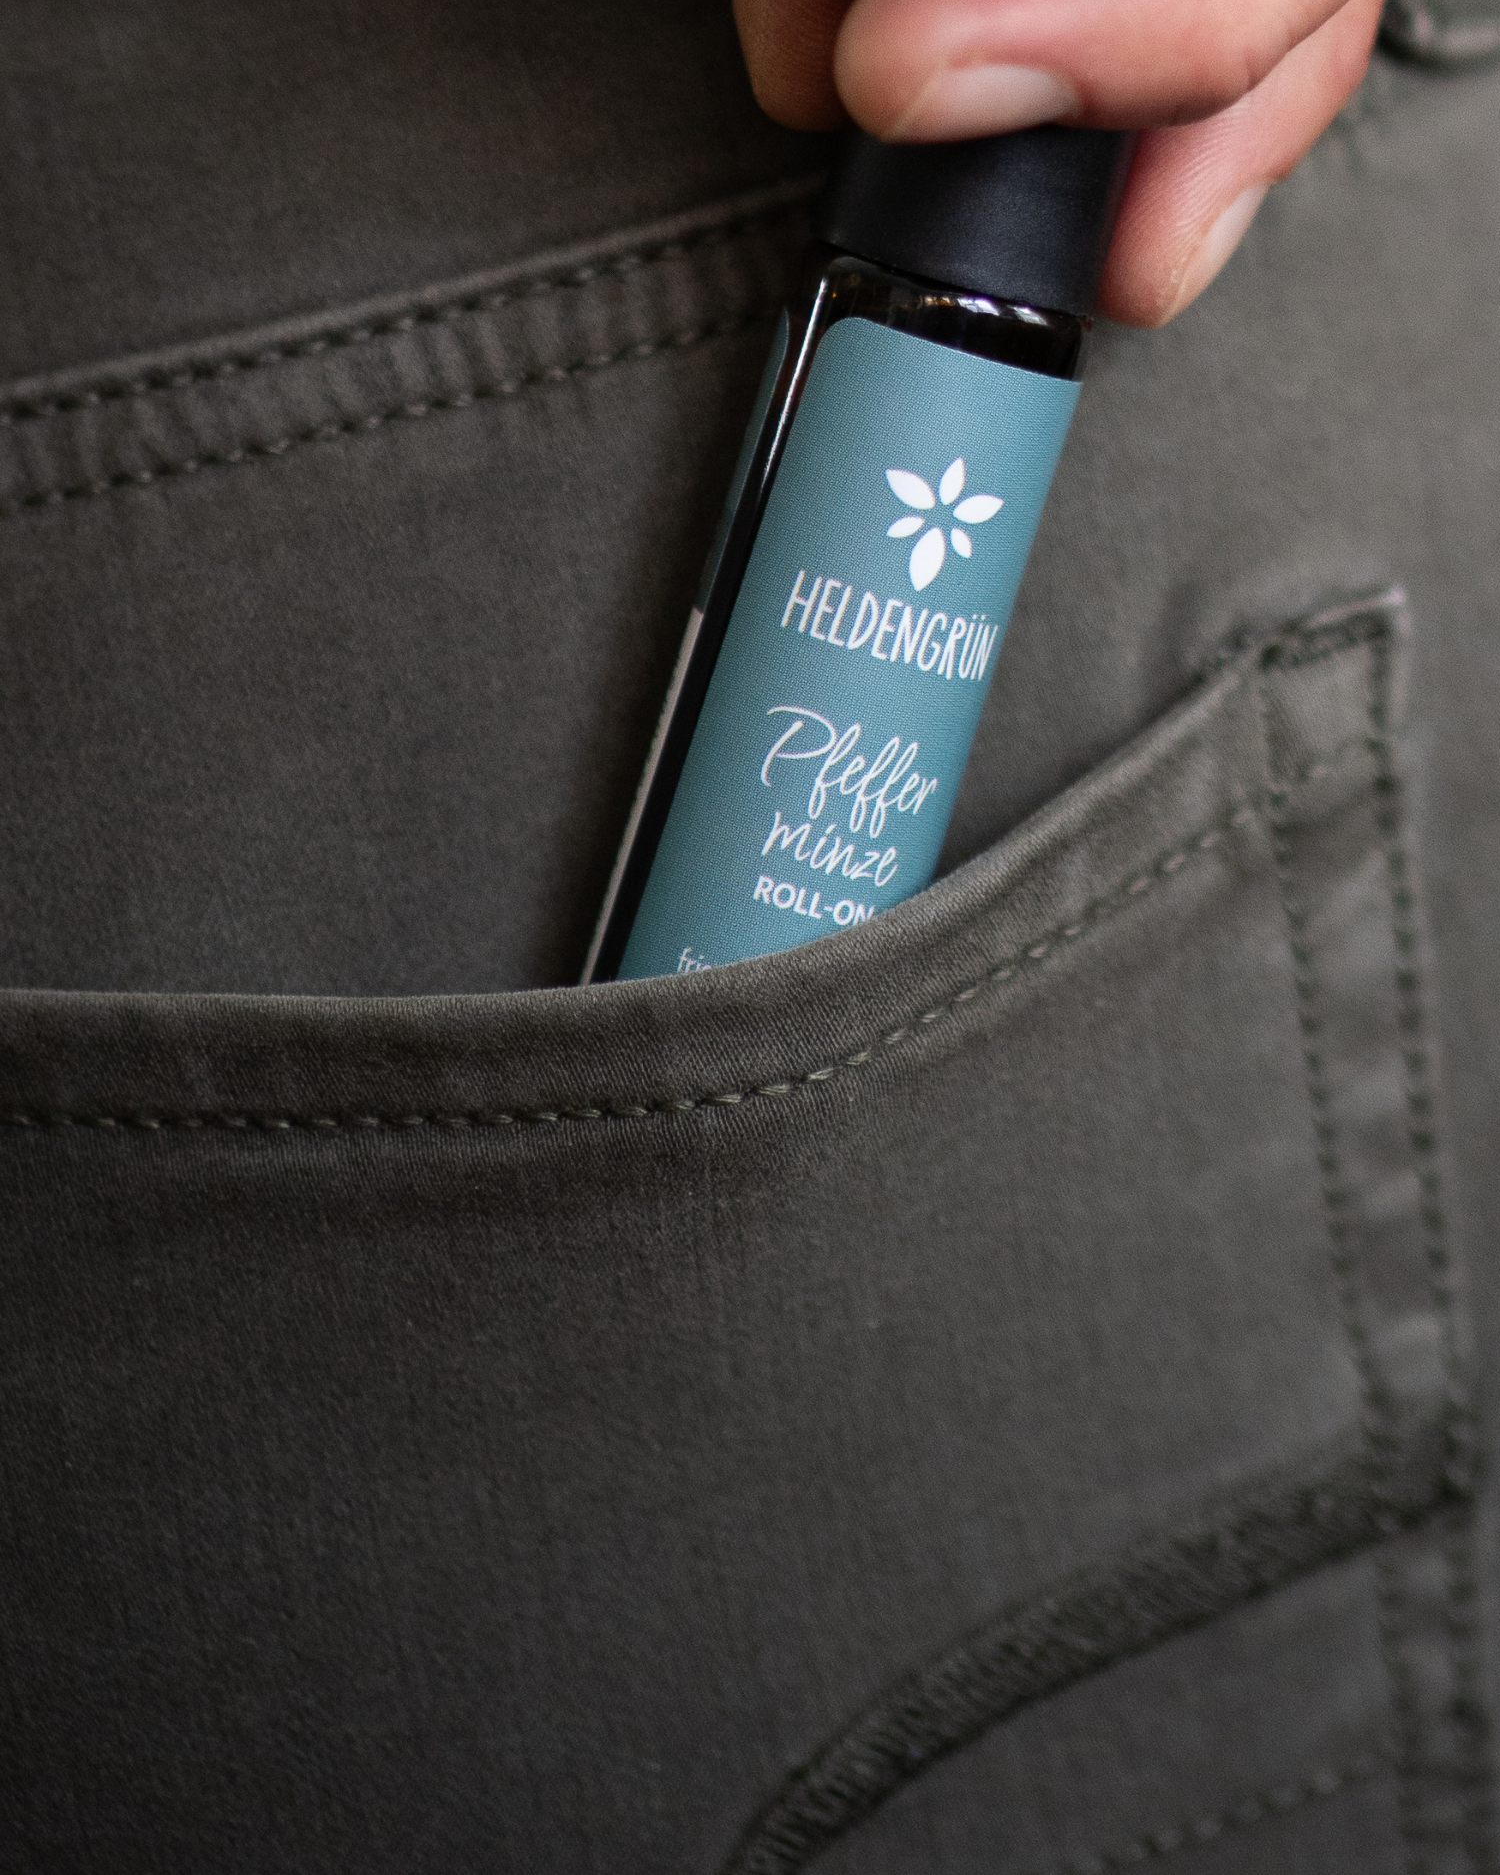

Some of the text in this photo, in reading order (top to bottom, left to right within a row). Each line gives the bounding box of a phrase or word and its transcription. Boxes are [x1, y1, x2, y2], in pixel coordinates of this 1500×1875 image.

[781, 570, 998, 680] HELDENGRÜN
[761, 706, 937, 838] Pfeffer
[761, 811, 897, 887] minze
[753, 875, 875, 926] ROLL-ON
